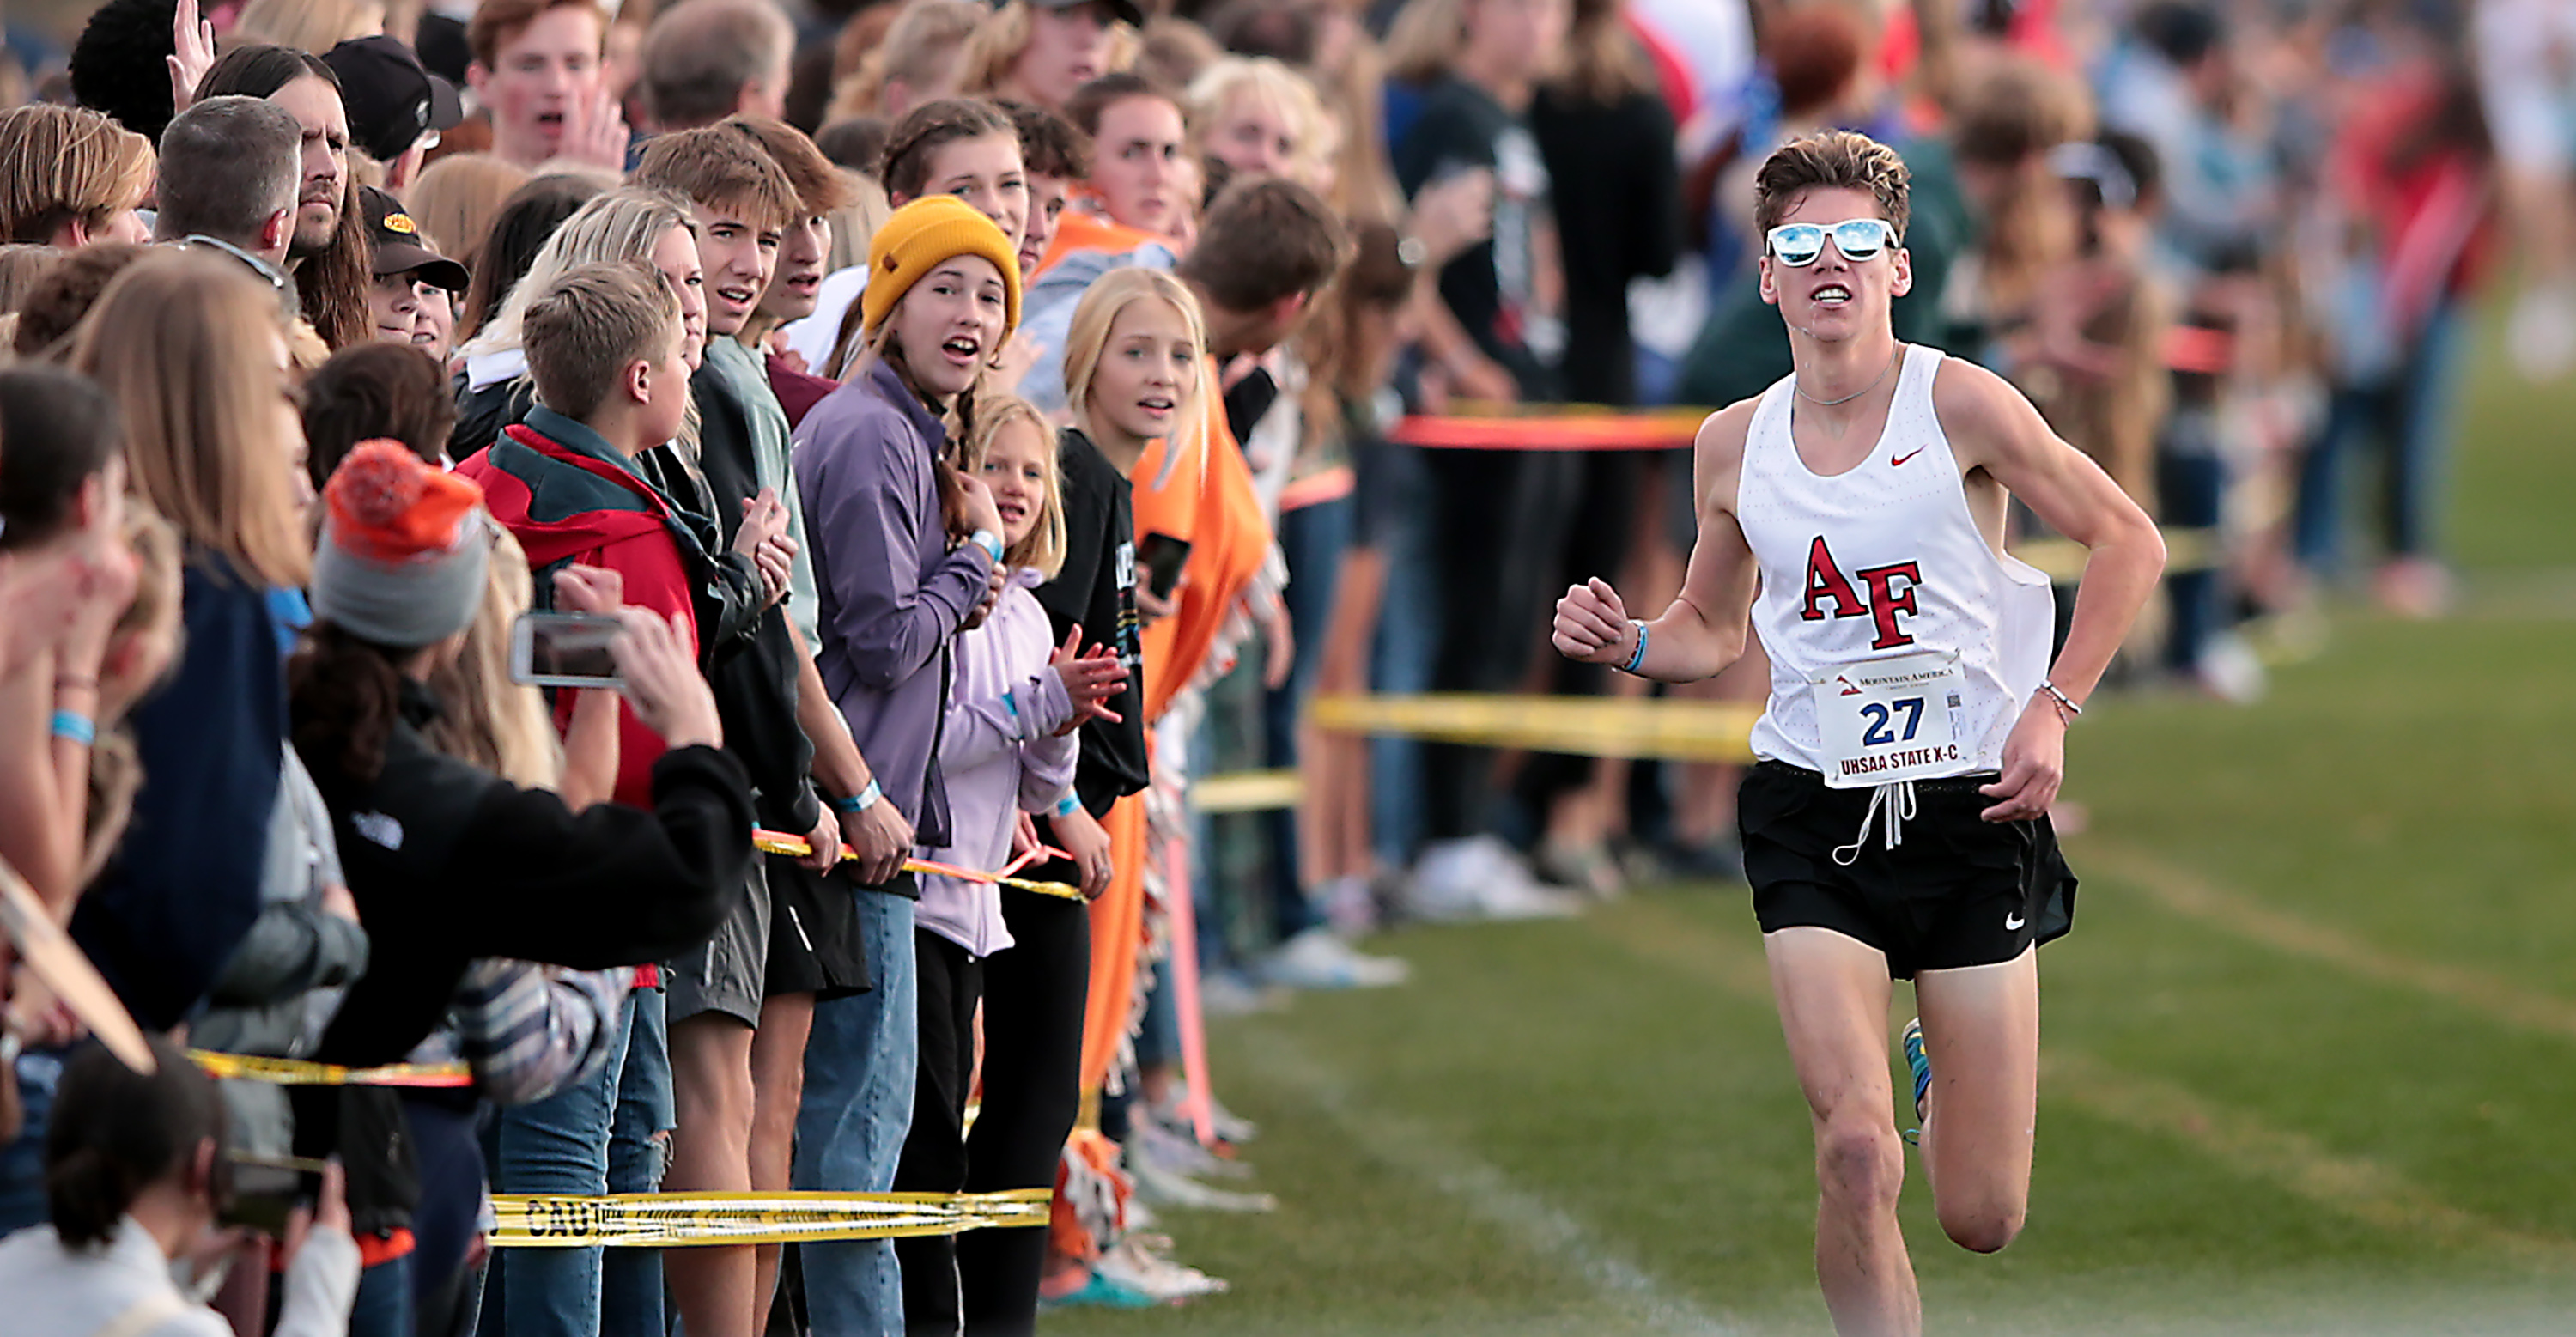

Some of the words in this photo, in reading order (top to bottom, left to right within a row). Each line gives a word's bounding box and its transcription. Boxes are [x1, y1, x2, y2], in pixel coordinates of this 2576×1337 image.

[1859, 697, 1925, 747] 27
[1840, 755, 1887, 775] UHSAA
[1890, 748, 1931, 769] STATE
[1934, 744, 1959, 763] X-C
